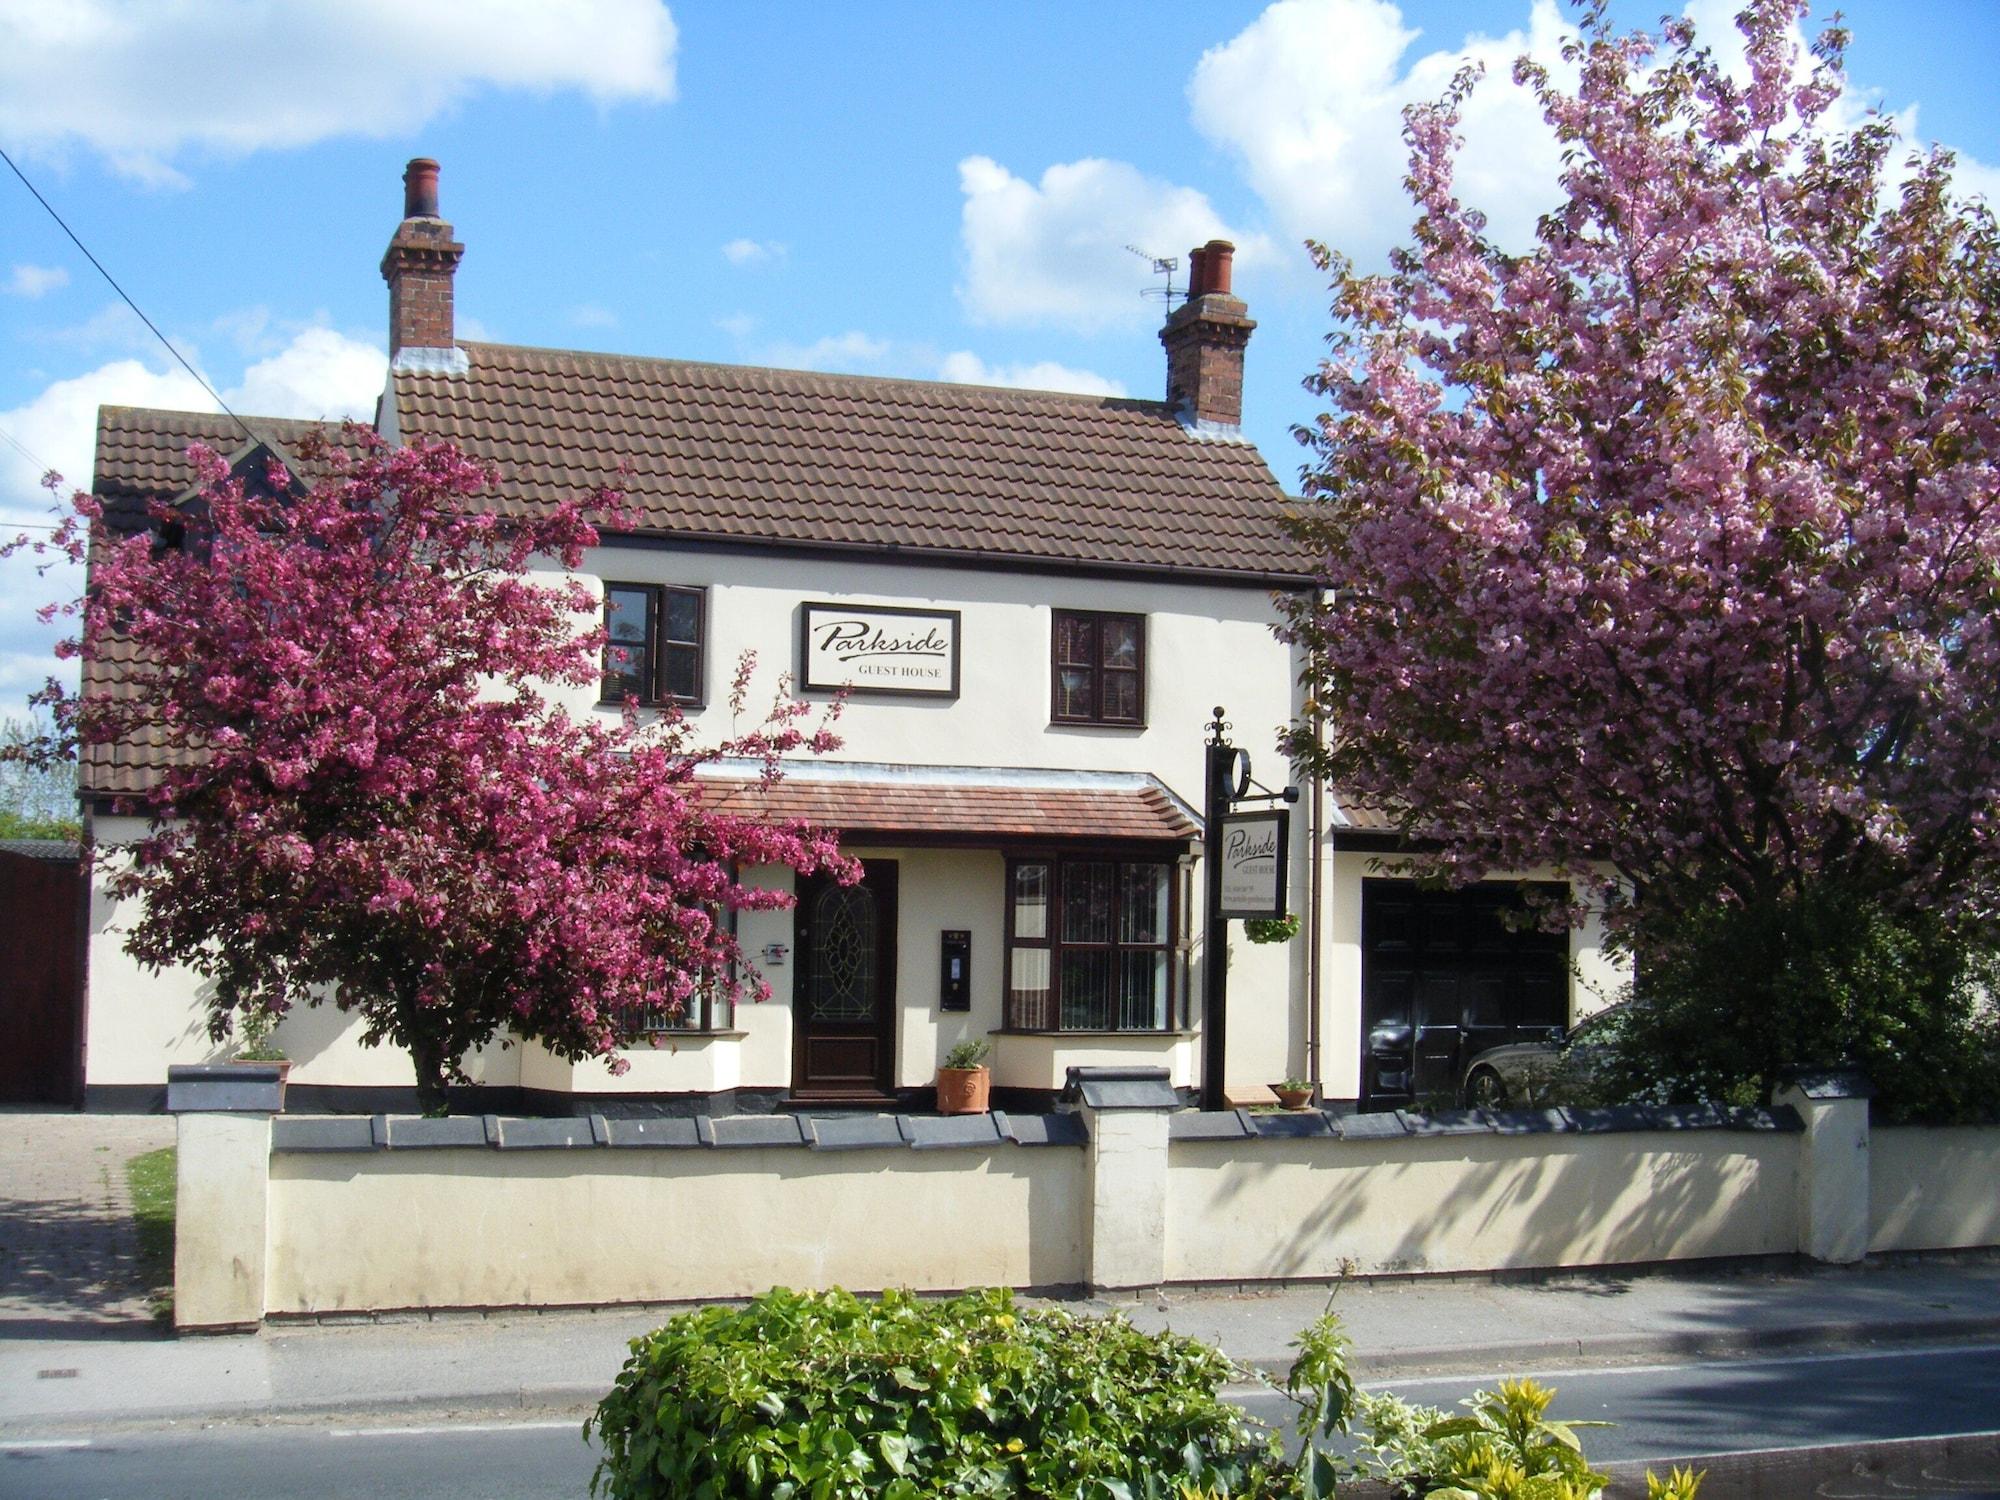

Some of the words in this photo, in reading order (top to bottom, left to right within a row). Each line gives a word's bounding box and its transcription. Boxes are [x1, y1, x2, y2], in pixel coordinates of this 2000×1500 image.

[814, 621, 949, 652] Parkside
[858, 664, 898, 676] GUEST
[901, 667, 941, 678] HOUSE
[1225, 829, 1276, 860] Parkside
